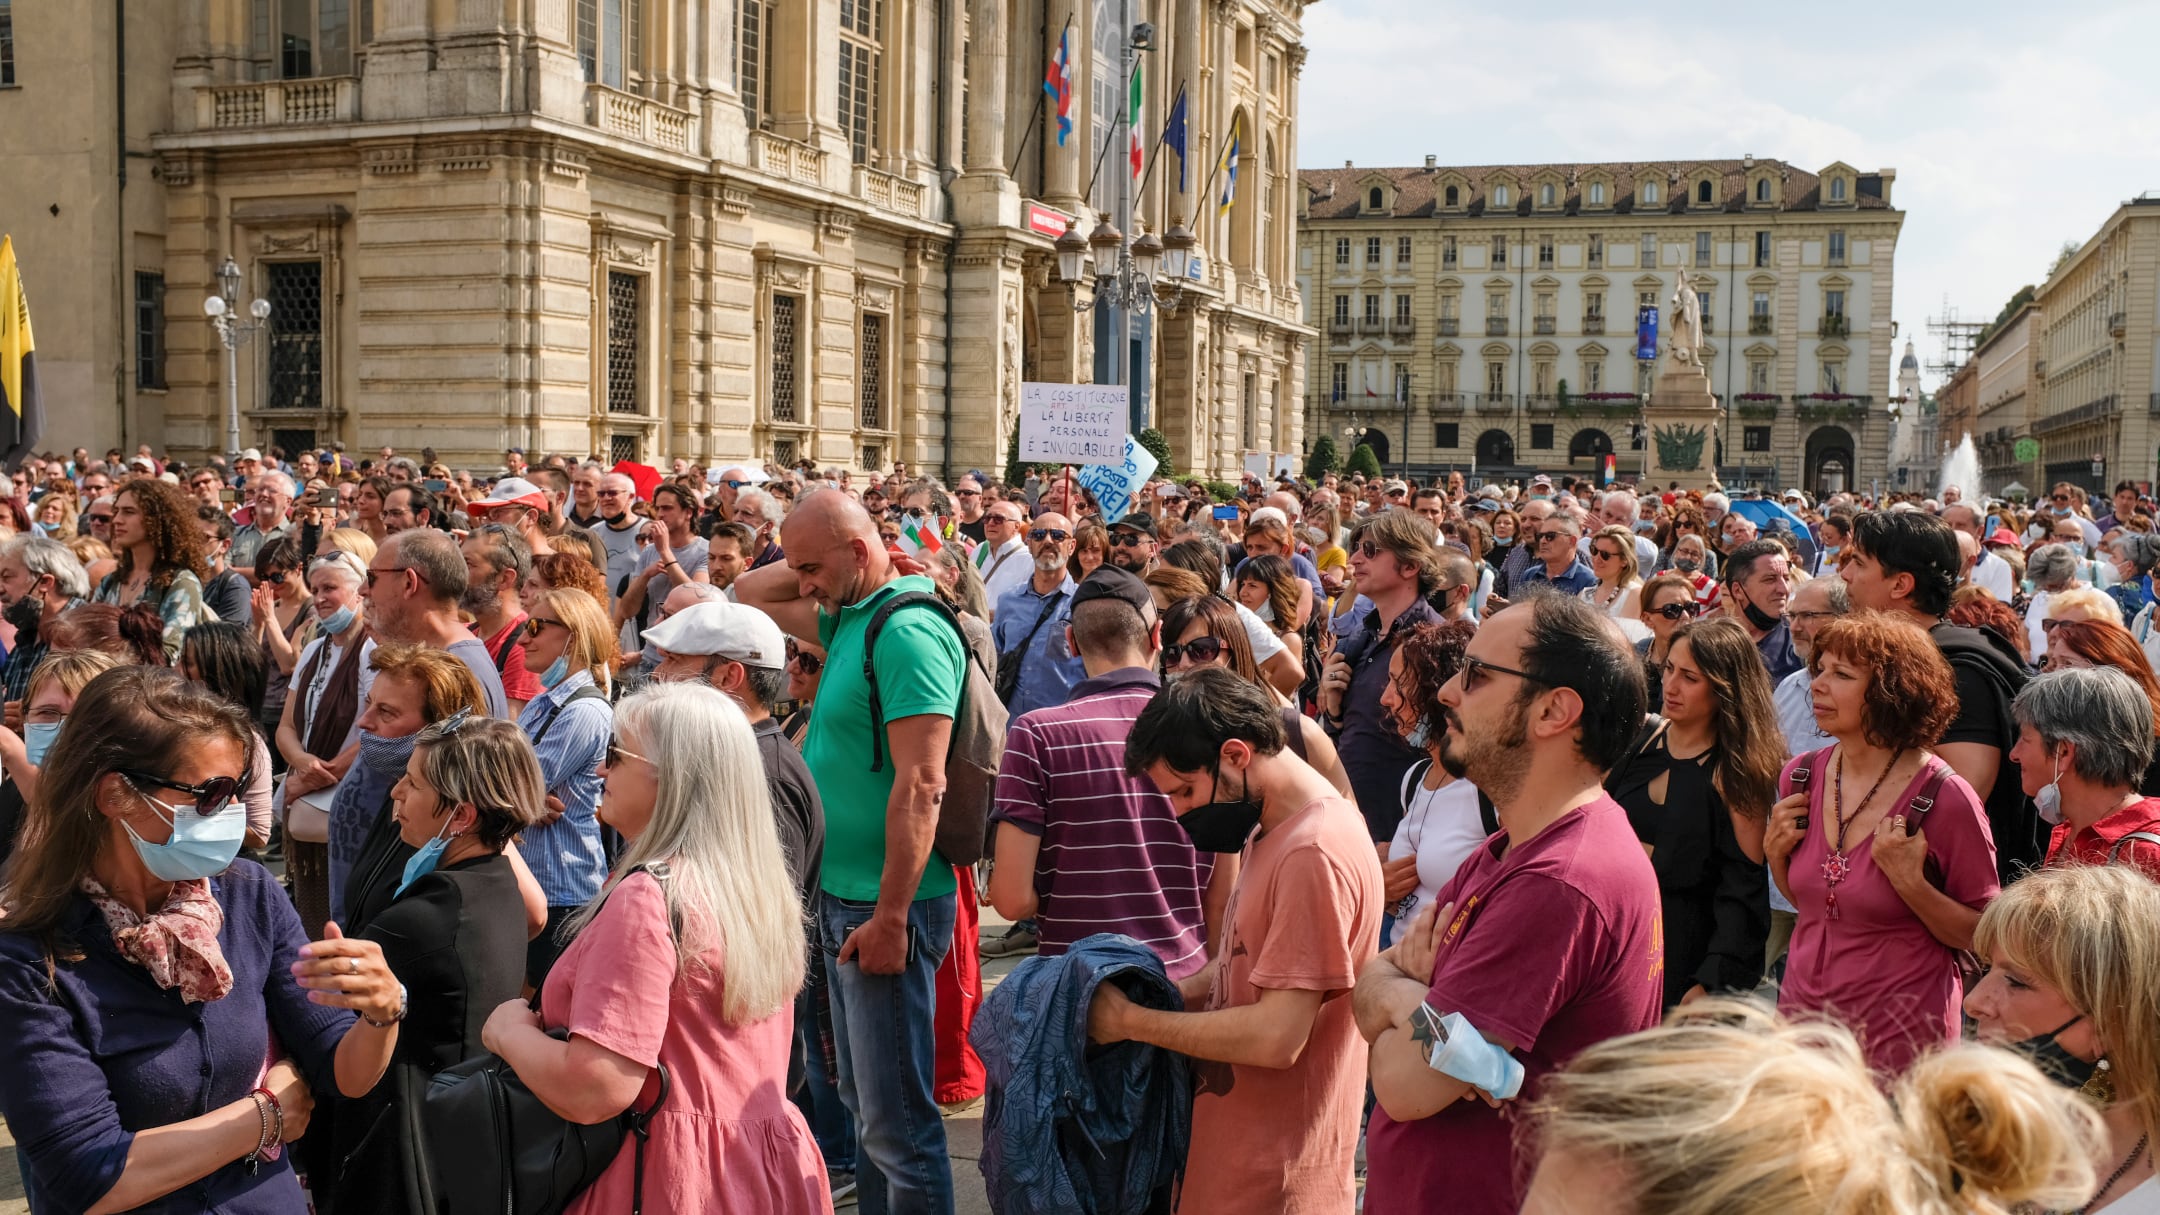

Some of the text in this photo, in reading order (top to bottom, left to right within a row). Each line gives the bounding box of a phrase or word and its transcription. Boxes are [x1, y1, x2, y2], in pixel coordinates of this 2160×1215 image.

[1027, 388, 1126, 404] LA COSTITUZIONE
[1041, 411, 1054, 421] LA
[1050, 426, 1109, 437] PERSONALE
[1042, 440, 1116, 457] INVIOLABILE
[1095, 464, 1129, 488] POSTO
